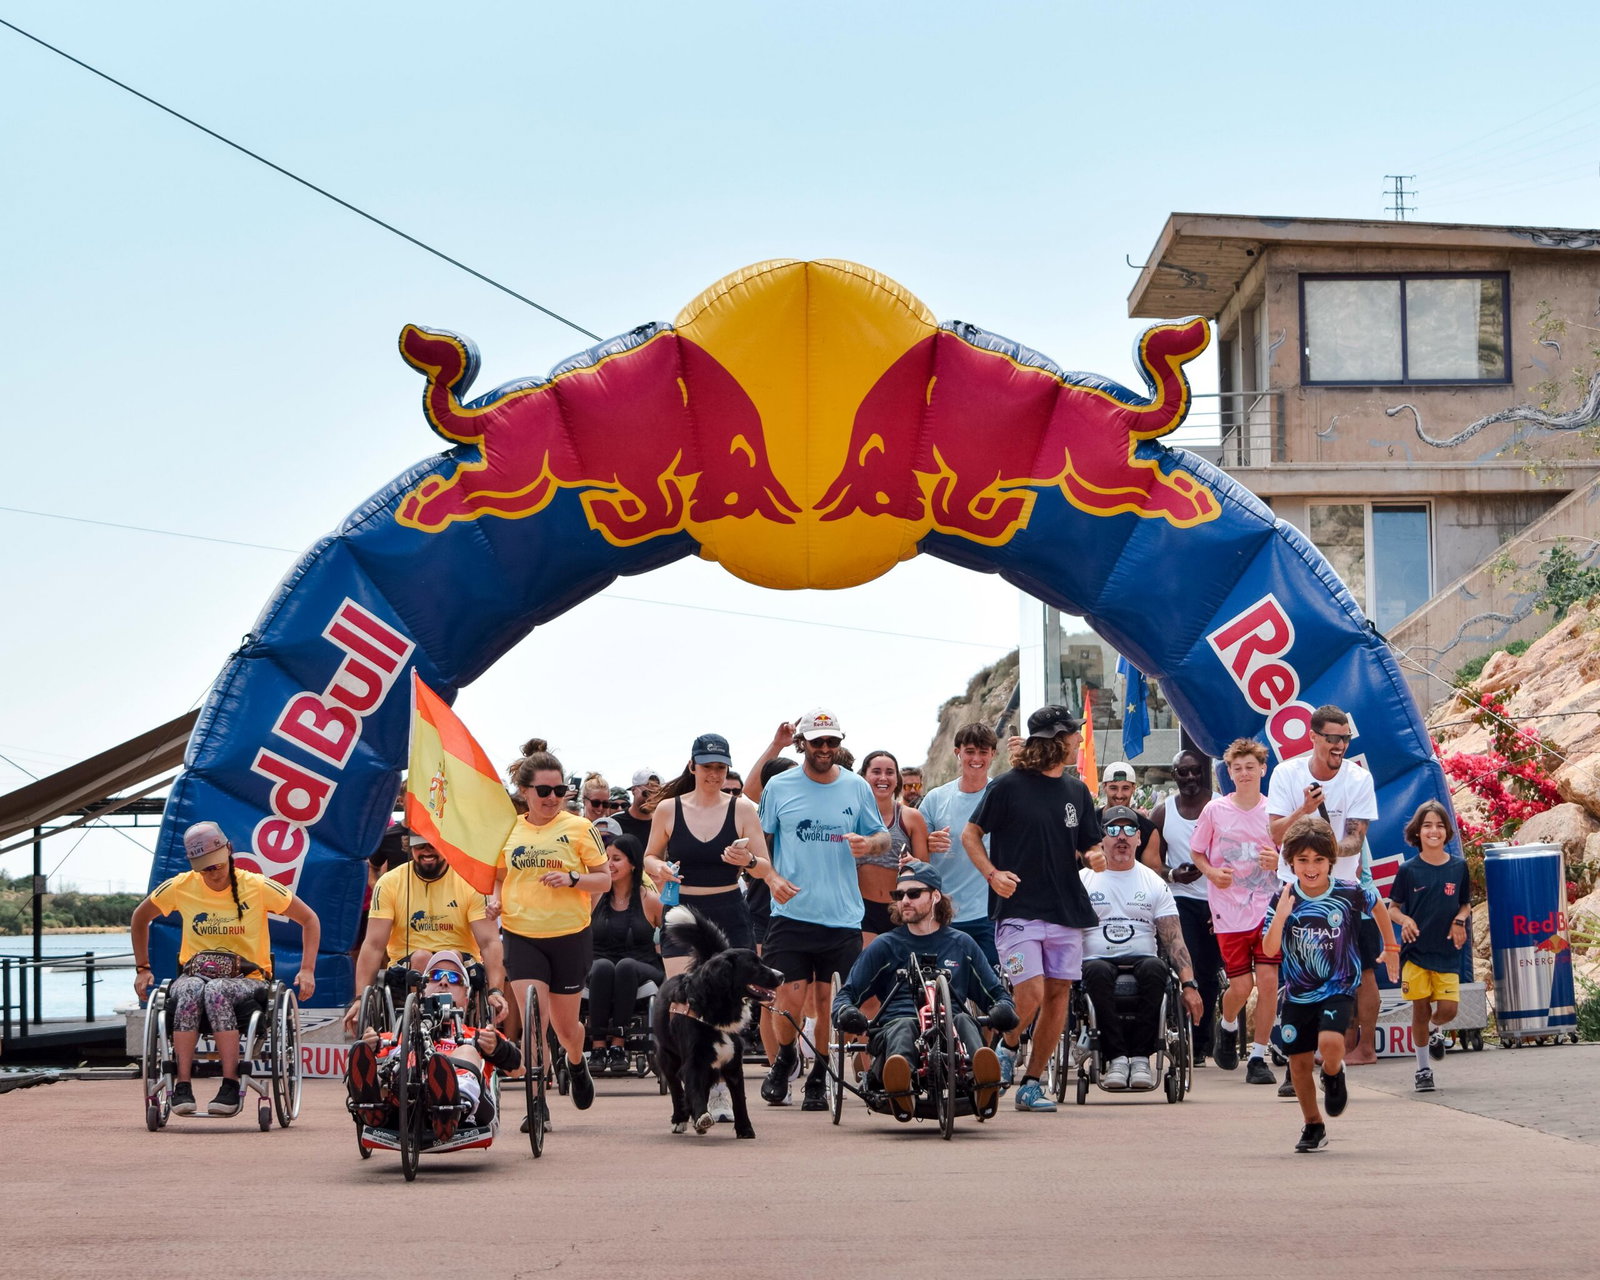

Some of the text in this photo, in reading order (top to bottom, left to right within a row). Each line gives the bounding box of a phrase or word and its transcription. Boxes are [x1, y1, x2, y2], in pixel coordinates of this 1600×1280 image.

[276, 601, 412, 765] Bull
[1210, 597, 1316, 761] Red
[804, 832, 843, 842] WORLD RUN
[518, 858, 562, 868] WORLD RUN
[418, 923, 454, 931] WORLD RUN
[1513, 911, 1555, 935] Red
[200, 925, 245, 935] WORLD RUN
[1292, 926, 1341, 939] ETIHAD
[1520, 957, 1557, 967] ENERG
[301, 1047, 349, 1076] RUN
